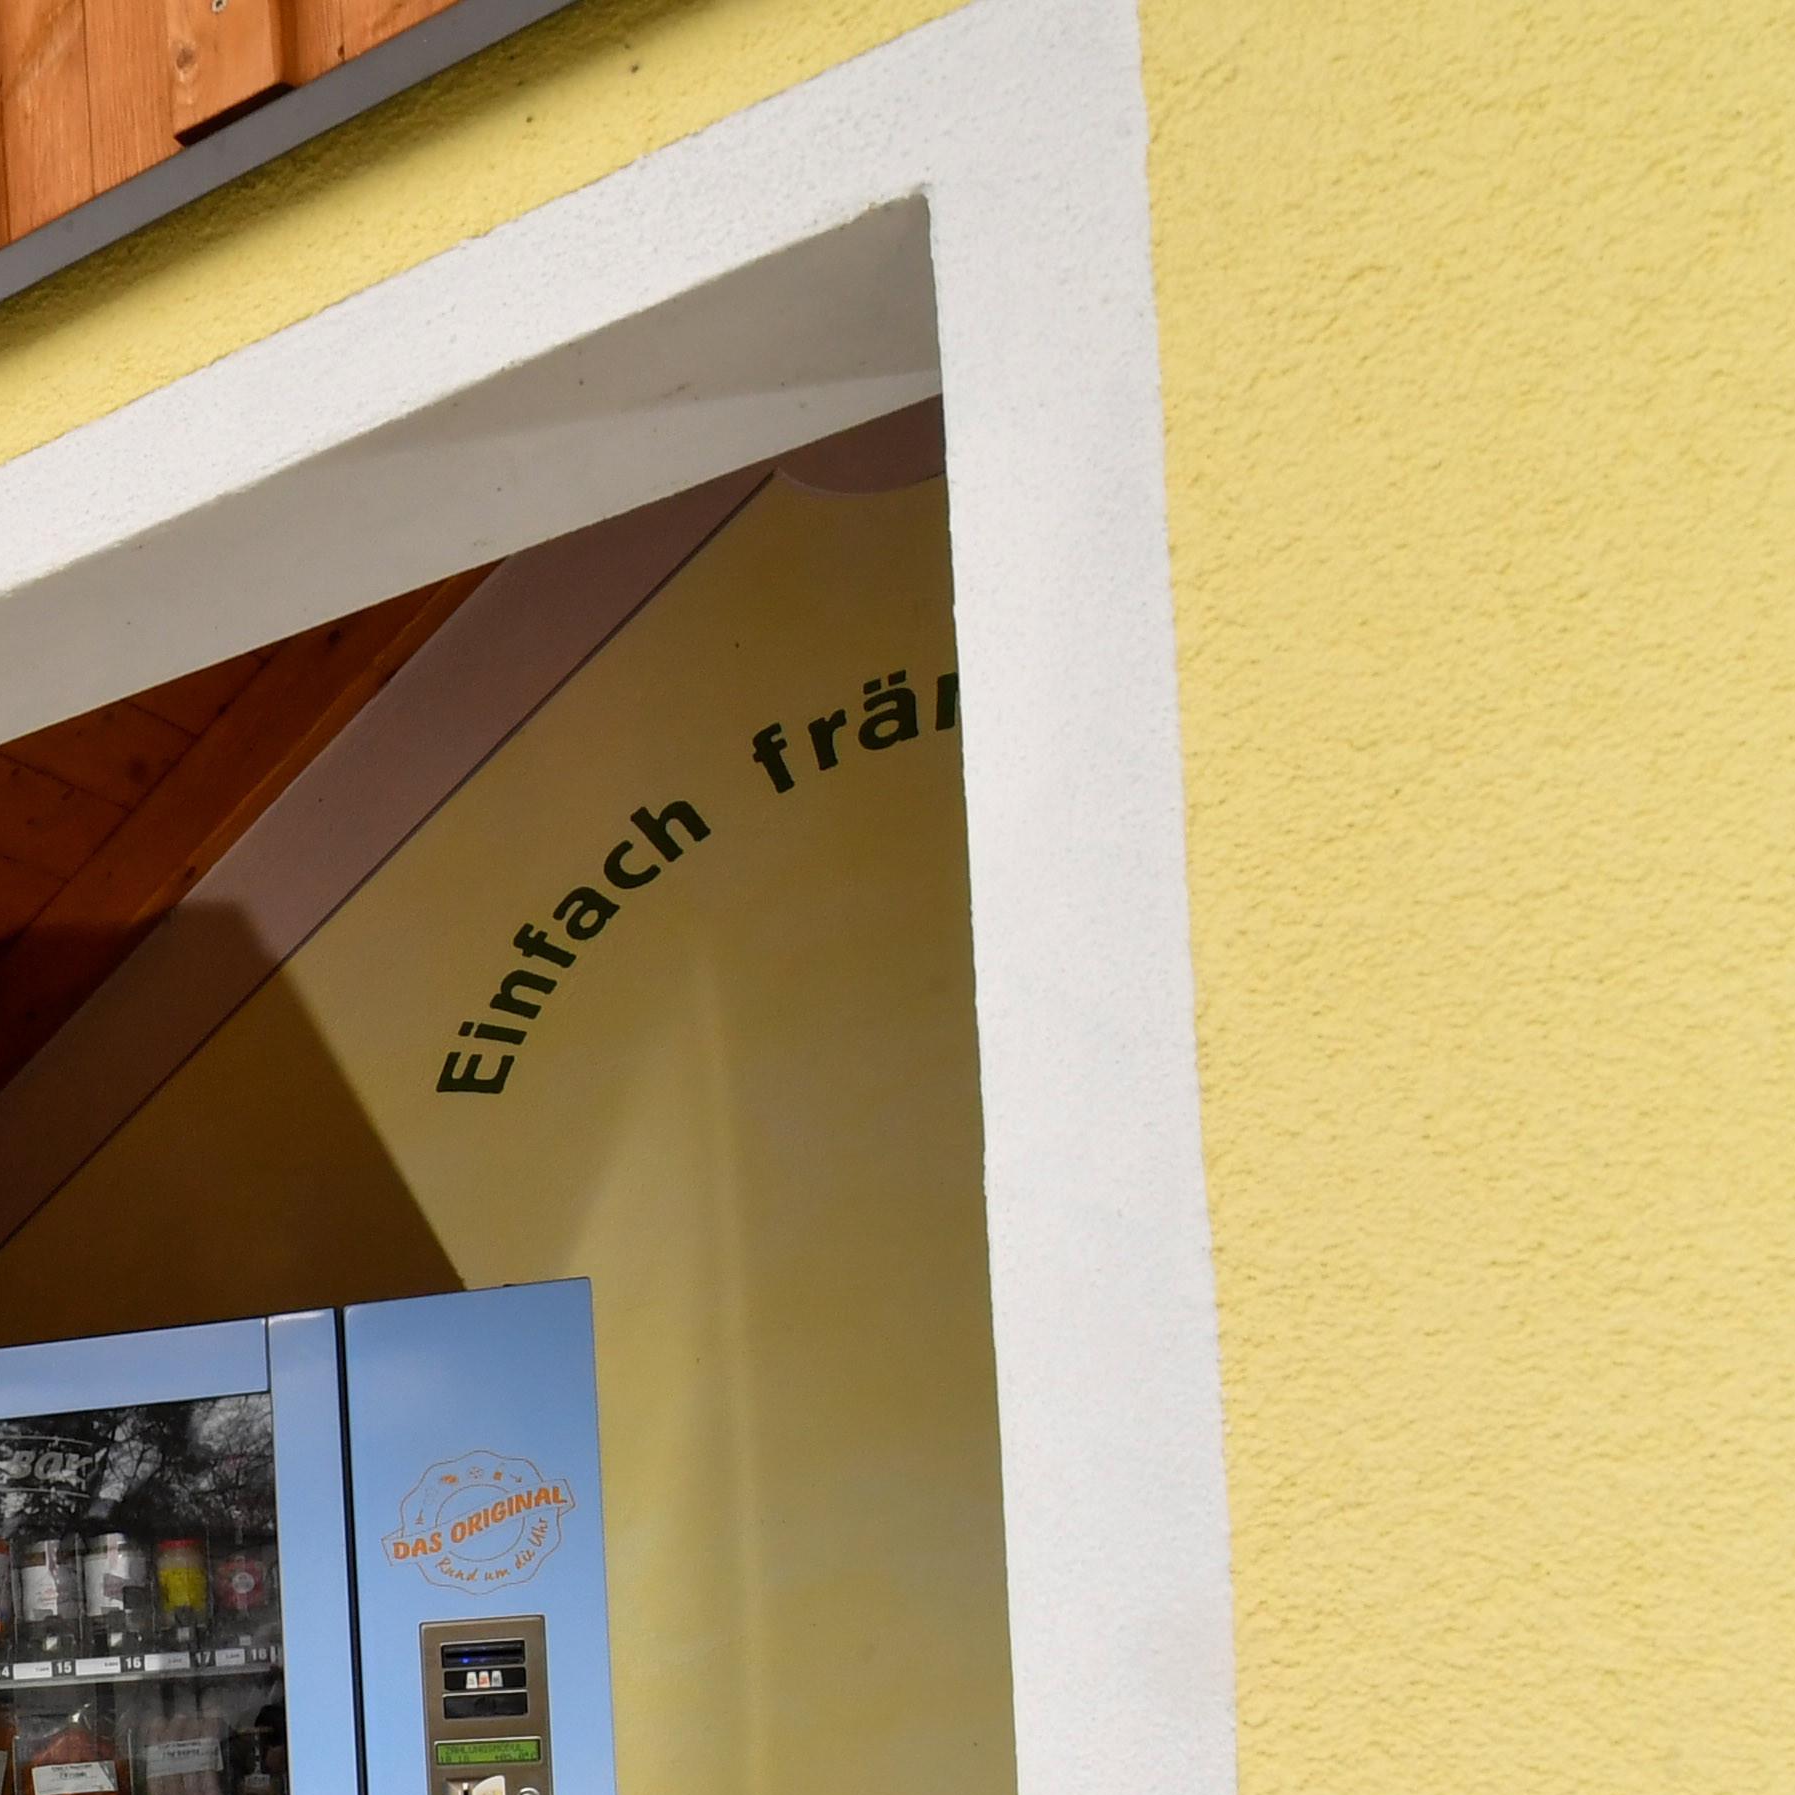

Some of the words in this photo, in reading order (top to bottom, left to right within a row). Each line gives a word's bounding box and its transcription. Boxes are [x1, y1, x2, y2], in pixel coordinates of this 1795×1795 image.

[436, 801, 711, 1094] Einfach
[393, 1532, 442, 1559] DAS
[451, 1486, 567, 1543] ORIGINAL
[435, 1557, 478, 1581] Rund
[485, 1568, 510, 1581] um
[515, 1550, 535, 1569] die
[528, 1517, 548, 1547] Uhr
[56, 1662, 72, 1674] 15
[125, 1657, 141, 1669] 16
[196, 1652, 210, 1664] 17
